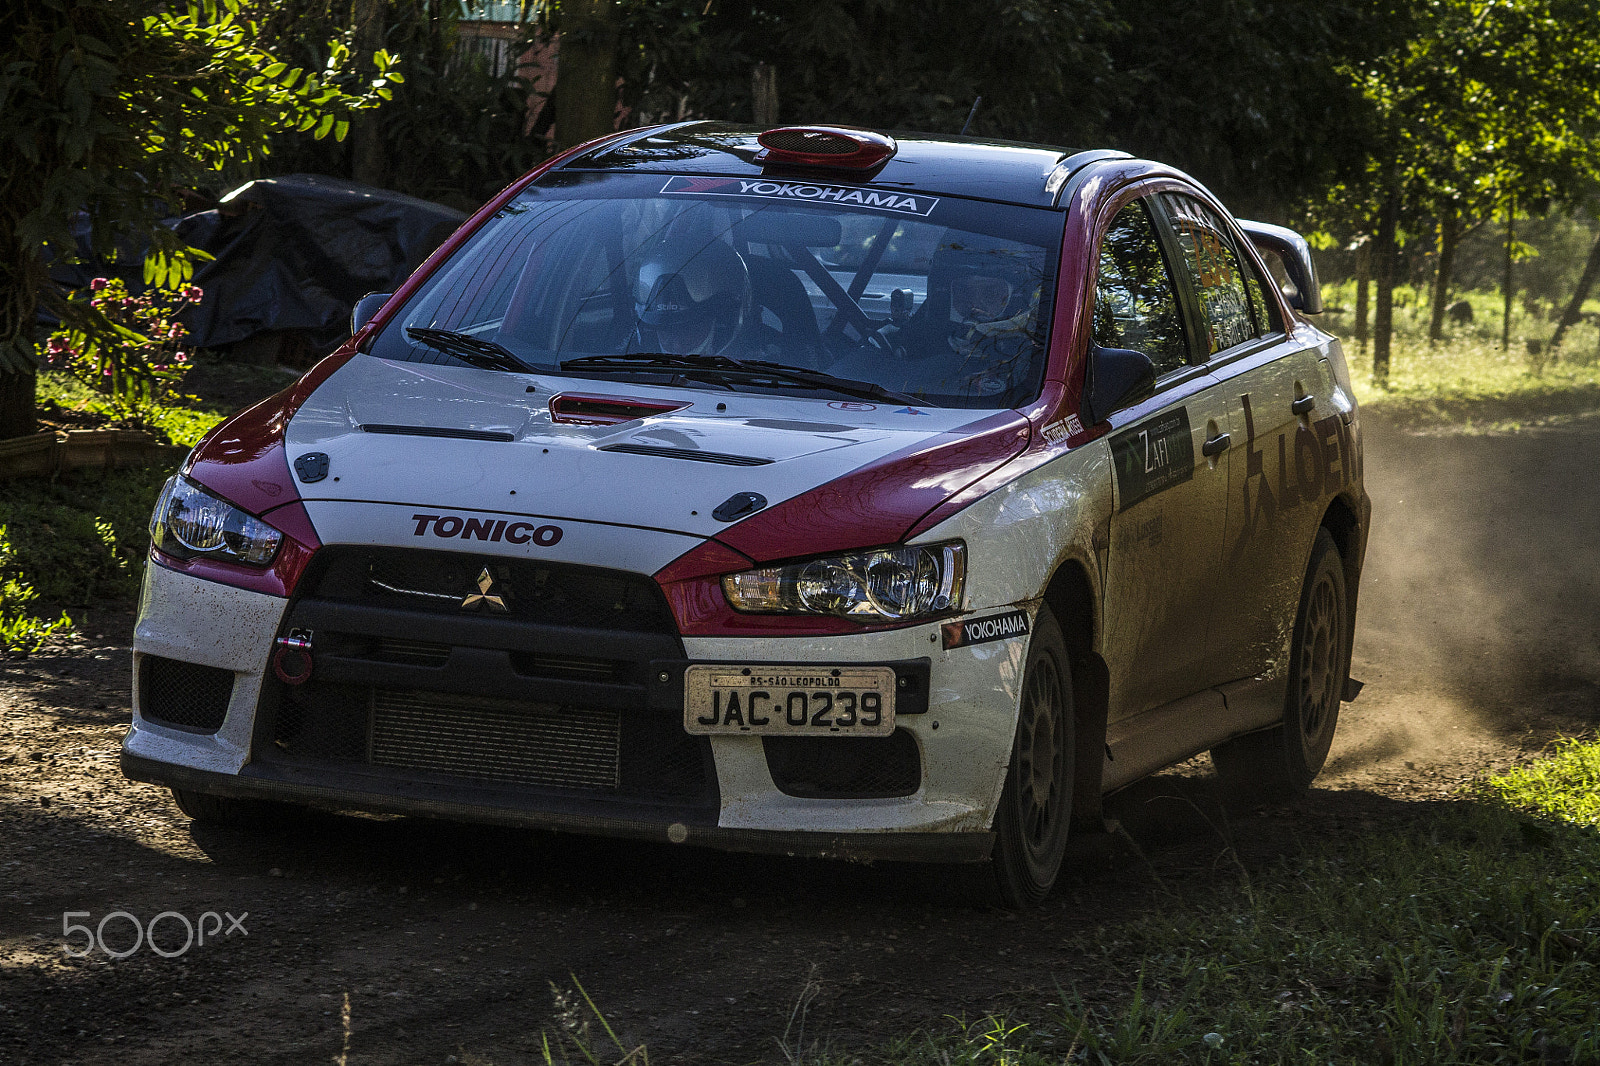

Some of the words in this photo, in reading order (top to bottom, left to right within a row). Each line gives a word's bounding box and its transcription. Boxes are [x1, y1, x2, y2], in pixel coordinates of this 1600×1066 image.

[740, 180, 918, 212] YOKOHAMA
[412, 514, 564, 547] TONICO
[964, 614, 1027, 641] YOKOHAMA
[789, 676, 841, 687] LEOPOLDO
